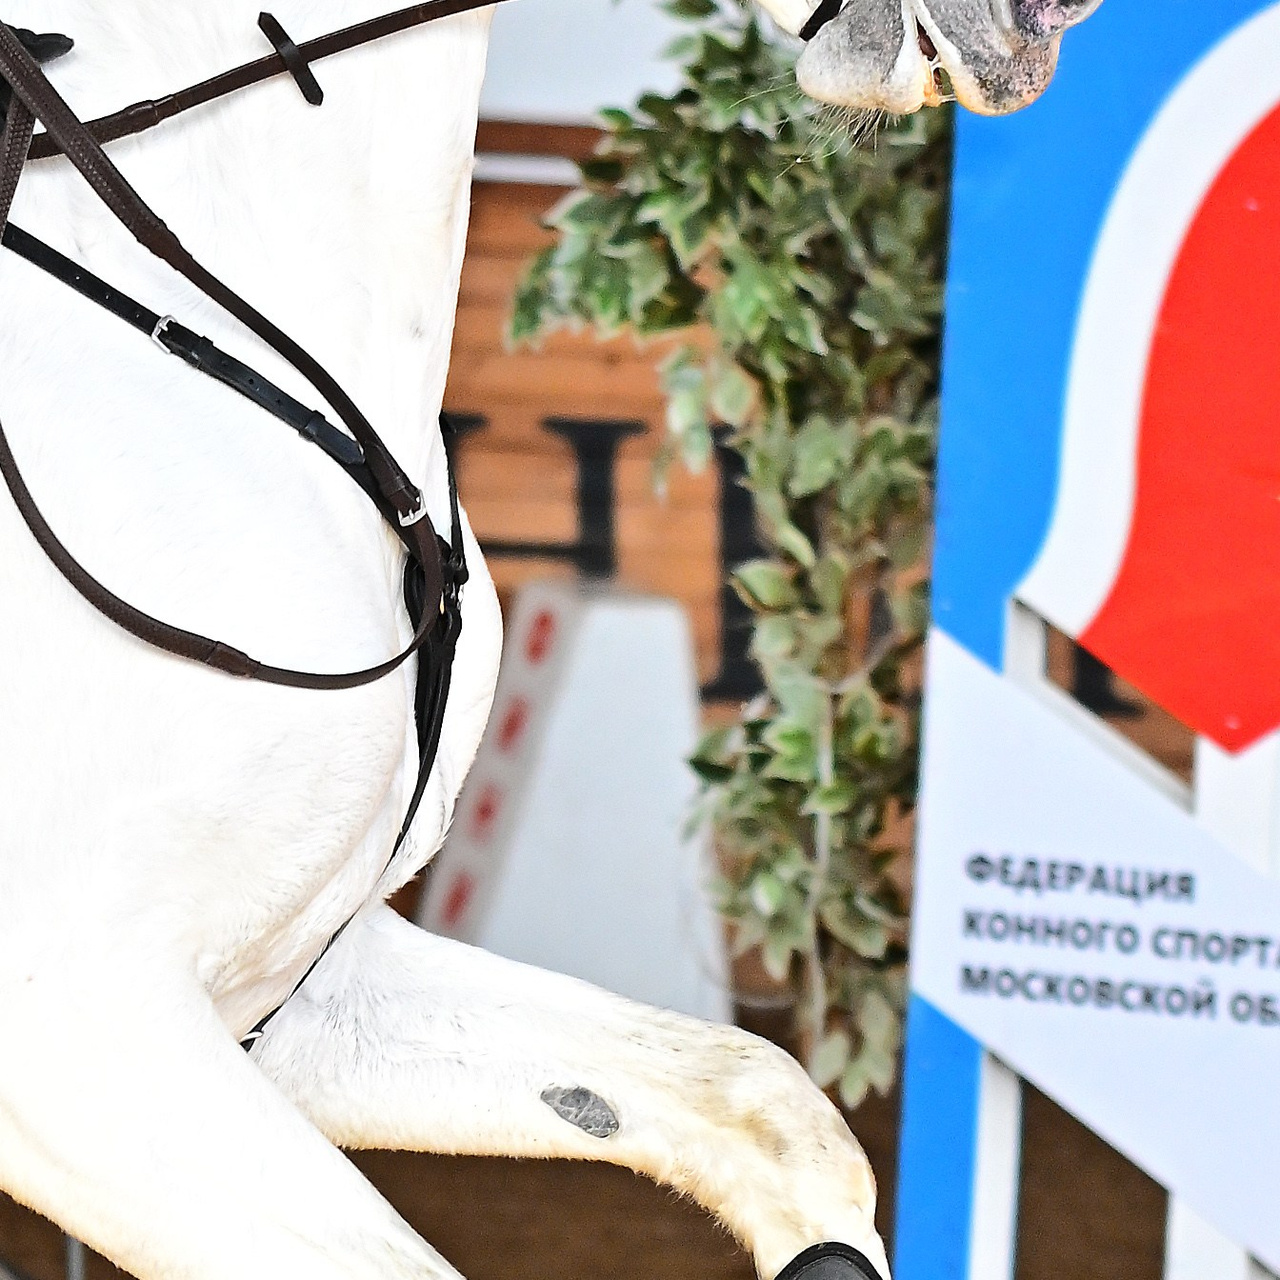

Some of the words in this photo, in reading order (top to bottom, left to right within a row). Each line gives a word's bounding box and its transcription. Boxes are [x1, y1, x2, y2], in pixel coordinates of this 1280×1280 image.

[965, 851, 1197, 905] ФЕДЕРАЦИЯ
[962, 908, 1140, 956] КОННОГО
[959, 964, 1217, 1020] МОСКОВСКОЙ
